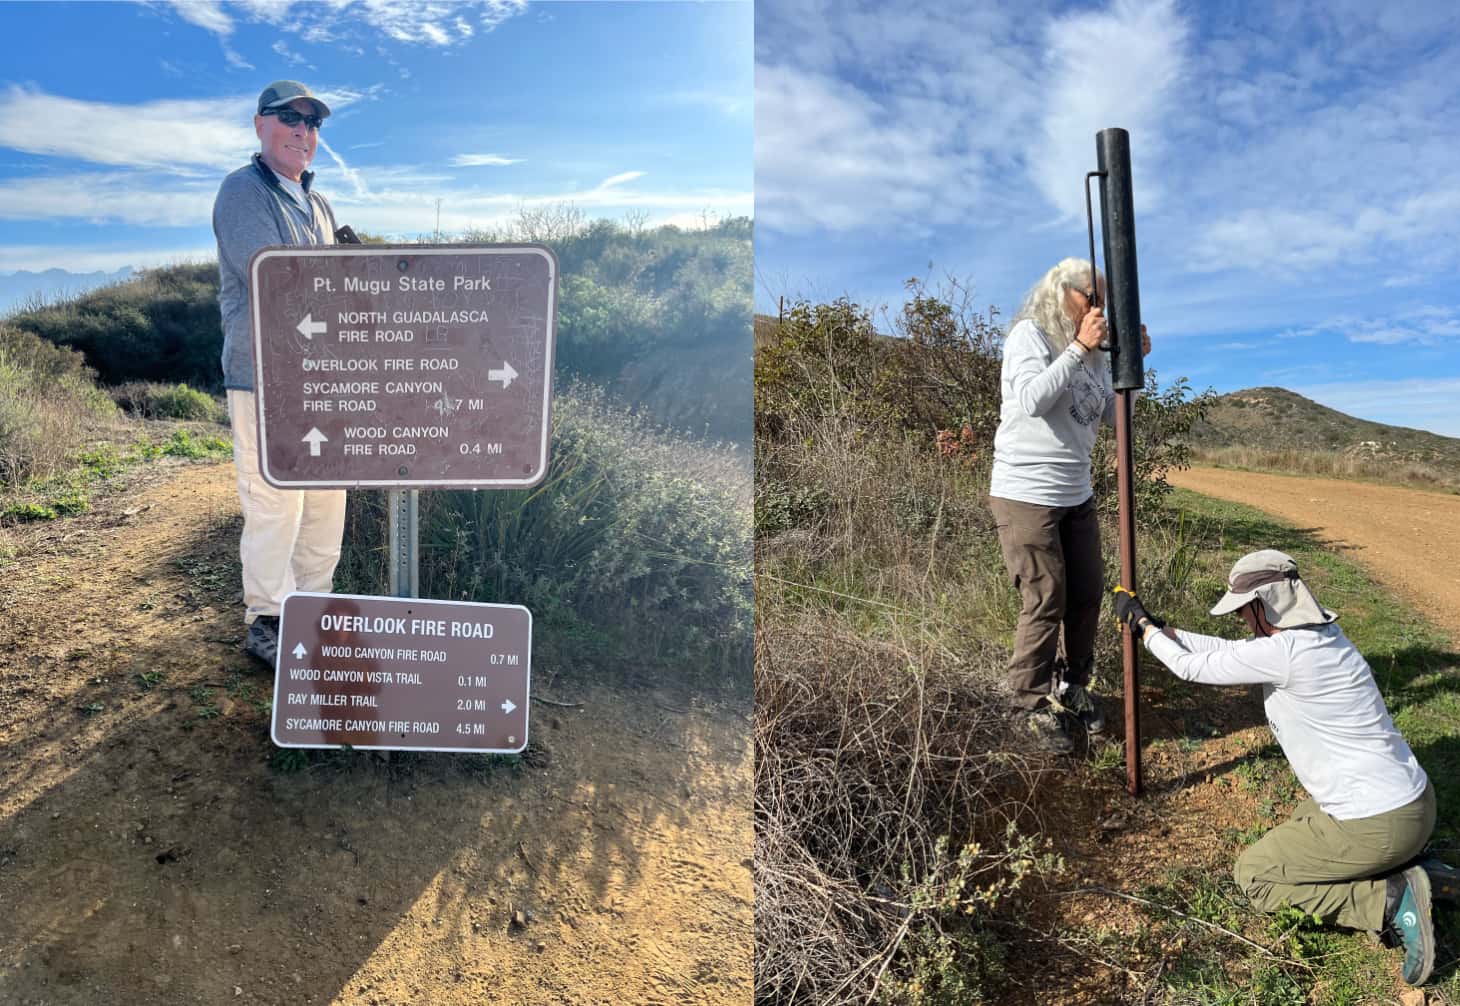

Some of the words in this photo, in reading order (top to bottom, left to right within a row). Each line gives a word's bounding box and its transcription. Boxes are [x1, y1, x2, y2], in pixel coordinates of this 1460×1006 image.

[313, 277, 336, 292] Pt.
[344, 277, 391, 294] Mugu
[398, 276, 445, 292] State
[454, 276, 491, 291] Park
[338, 312, 386, 324] NORTH
[393, 311, 489, 323] GUADALASCA
[339, 331, 368, 342] FIRE
[375, 331, 414, 342] ROAD
[303, 358, 378, 371] OVERLOOK
[384, 359, 413, 370] FIRE
[420, 358, 458, 370] ROAD
[303, 382, 379, 394] SYCAMORE
[385, 382, 442, 393] CANYON
[303, 401, 332, 411] FIRE
[339, 400, 376, 411] ROAD
[468, 399, 484, 410] MI
[344, 427, 386, 439] WOOD
[393, 427, 448, 438] CANYON
[344, 444, 372, 455] FIRE
[379, 444, 416, 455] ROAD
[460, 443, 481, 455] 0.4
[487, 443, 502, 454] MI
[321, 614, 406, 634] OVERLOOK
[412, 619, 445, 637] FIRE
[452, 622, 493, 639] ROAD
[321, 646, 351, 658] WOOD
[355, 648, 394, 660] CANYON
[397, 649, 418, 661] FIRE
[420, 650, 446, 662] ROAD
[491, 654, 504, 665] 0.7
[507, 655, 519, 665] MI
[290, 668, 320, 681] WOOD
[323, 670, 363, 682] CANYON
[366, 671, 393, 683] VISTA
[396, 673, 422, 685] TRAIL
[458, 676, 472, 686] 0.1
[475, 676, 486, 687] MI
[288, 693, 307, 705] RAY
[311, 694, 347, 706] MILLER
[351, 696, 378, 707] TRAIL
[457, 700, 472, 711] 2.0
[475, 700, 485, 711] MI
[286, 718, 342, 731] SYCAMORE
[345, 720, 385, 732] CANYON
[389, 721, 410, 733] FIRE
[413, 722, 439, 734] ROAD
[456, 723, 471, 734] 4.5
[474, 724, 484, 735] MI
